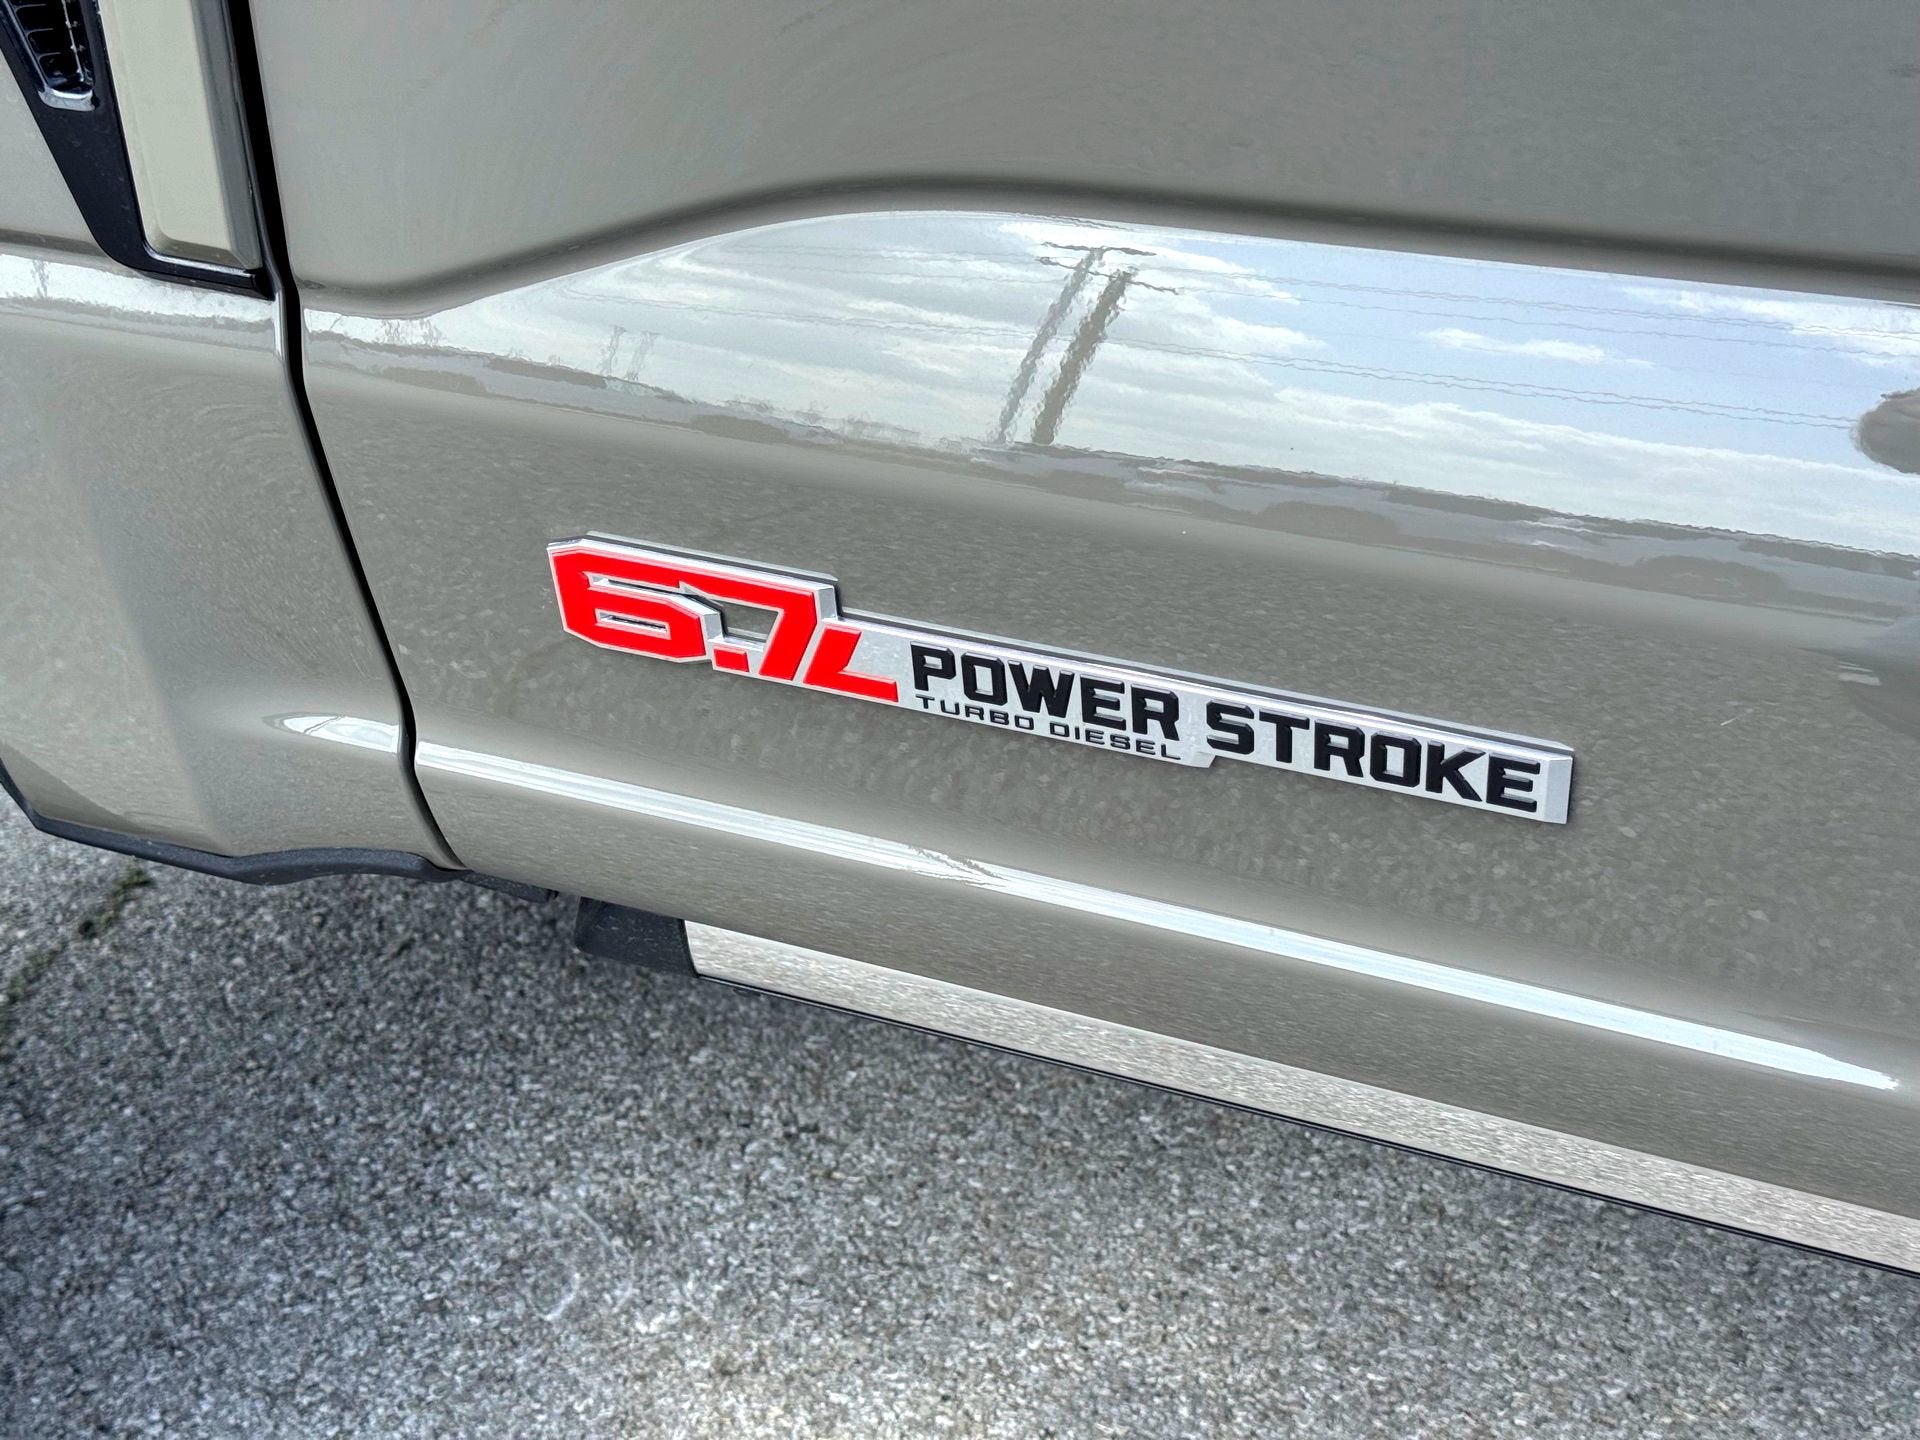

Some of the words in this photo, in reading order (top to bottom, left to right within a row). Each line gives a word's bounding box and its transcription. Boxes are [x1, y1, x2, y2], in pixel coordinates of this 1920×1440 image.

[551, 546, 899, 703] 6.7L
[910, 641, 1180, 742] POWER
[1206, 699, 1541, 813] STROKE
[915, 693, 1035, 731] TURBO
[1049, 722, 1181, 760] DIESEL
